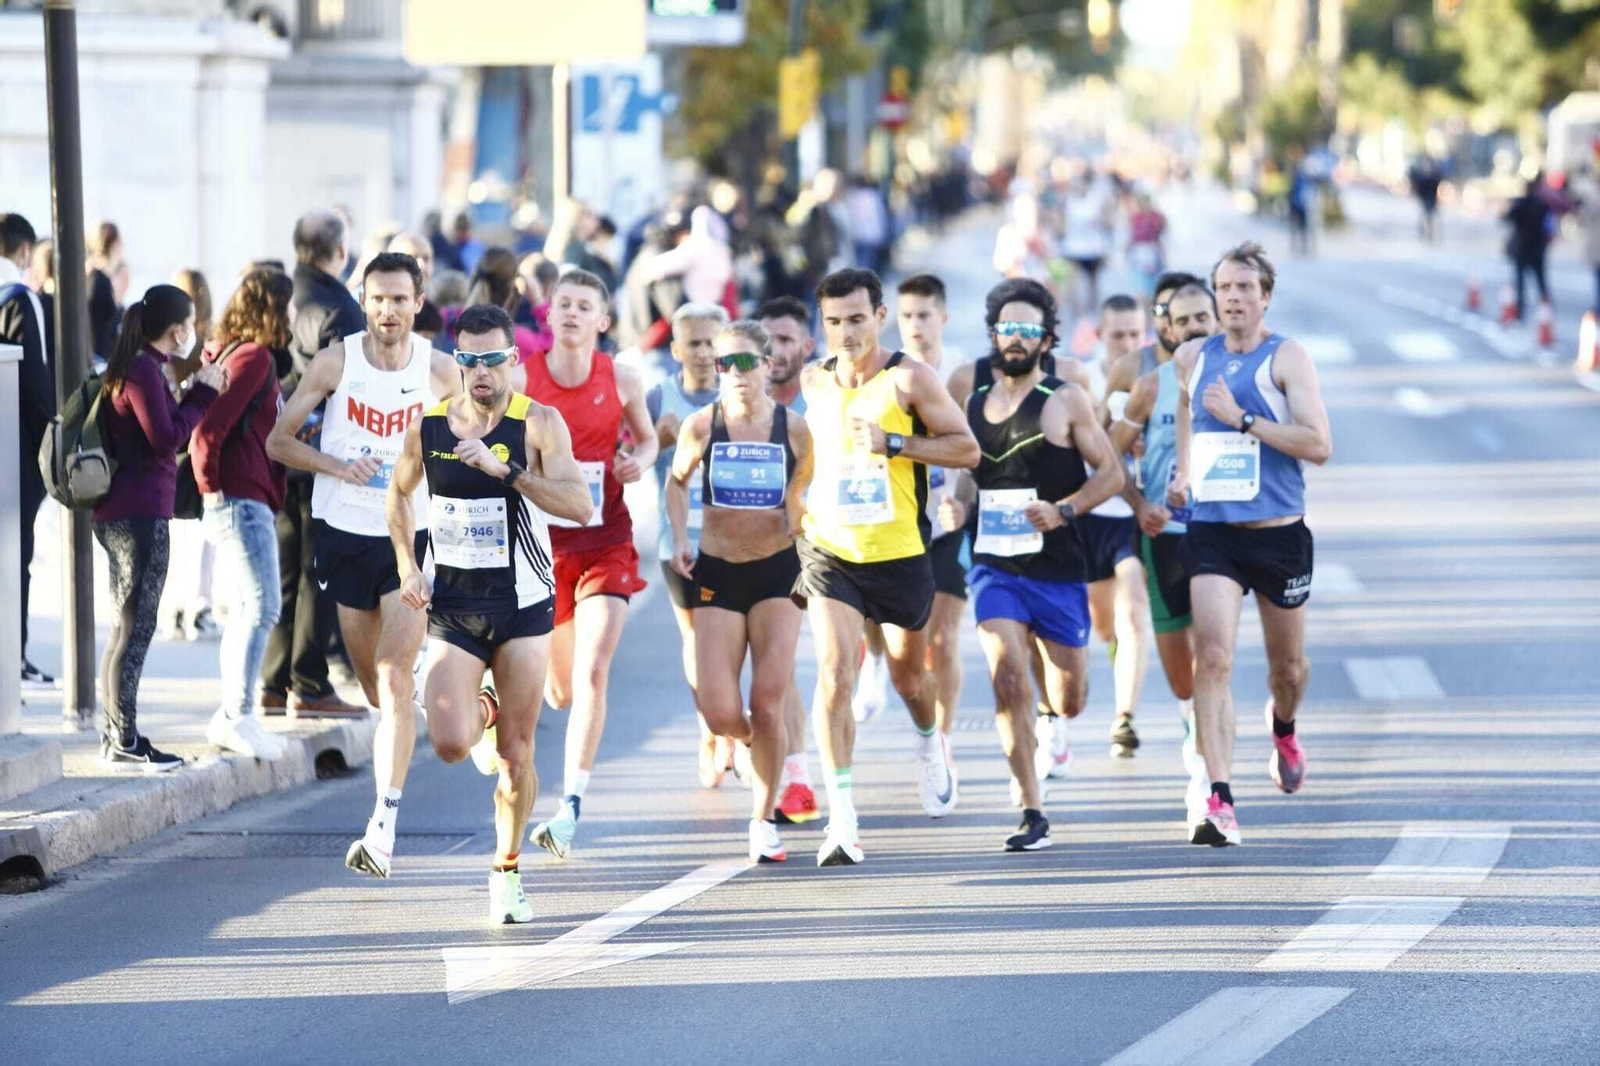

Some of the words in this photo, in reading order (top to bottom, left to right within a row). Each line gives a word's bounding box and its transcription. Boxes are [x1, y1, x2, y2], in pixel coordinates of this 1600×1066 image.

[740, 448, 770, 456] ZURICH
[376, 467, 393, 480] 45
[750, 467, 766, 480] 91
[458, 506, 489, 514] ZURICH
[462, 526, 493, 537] 7946
